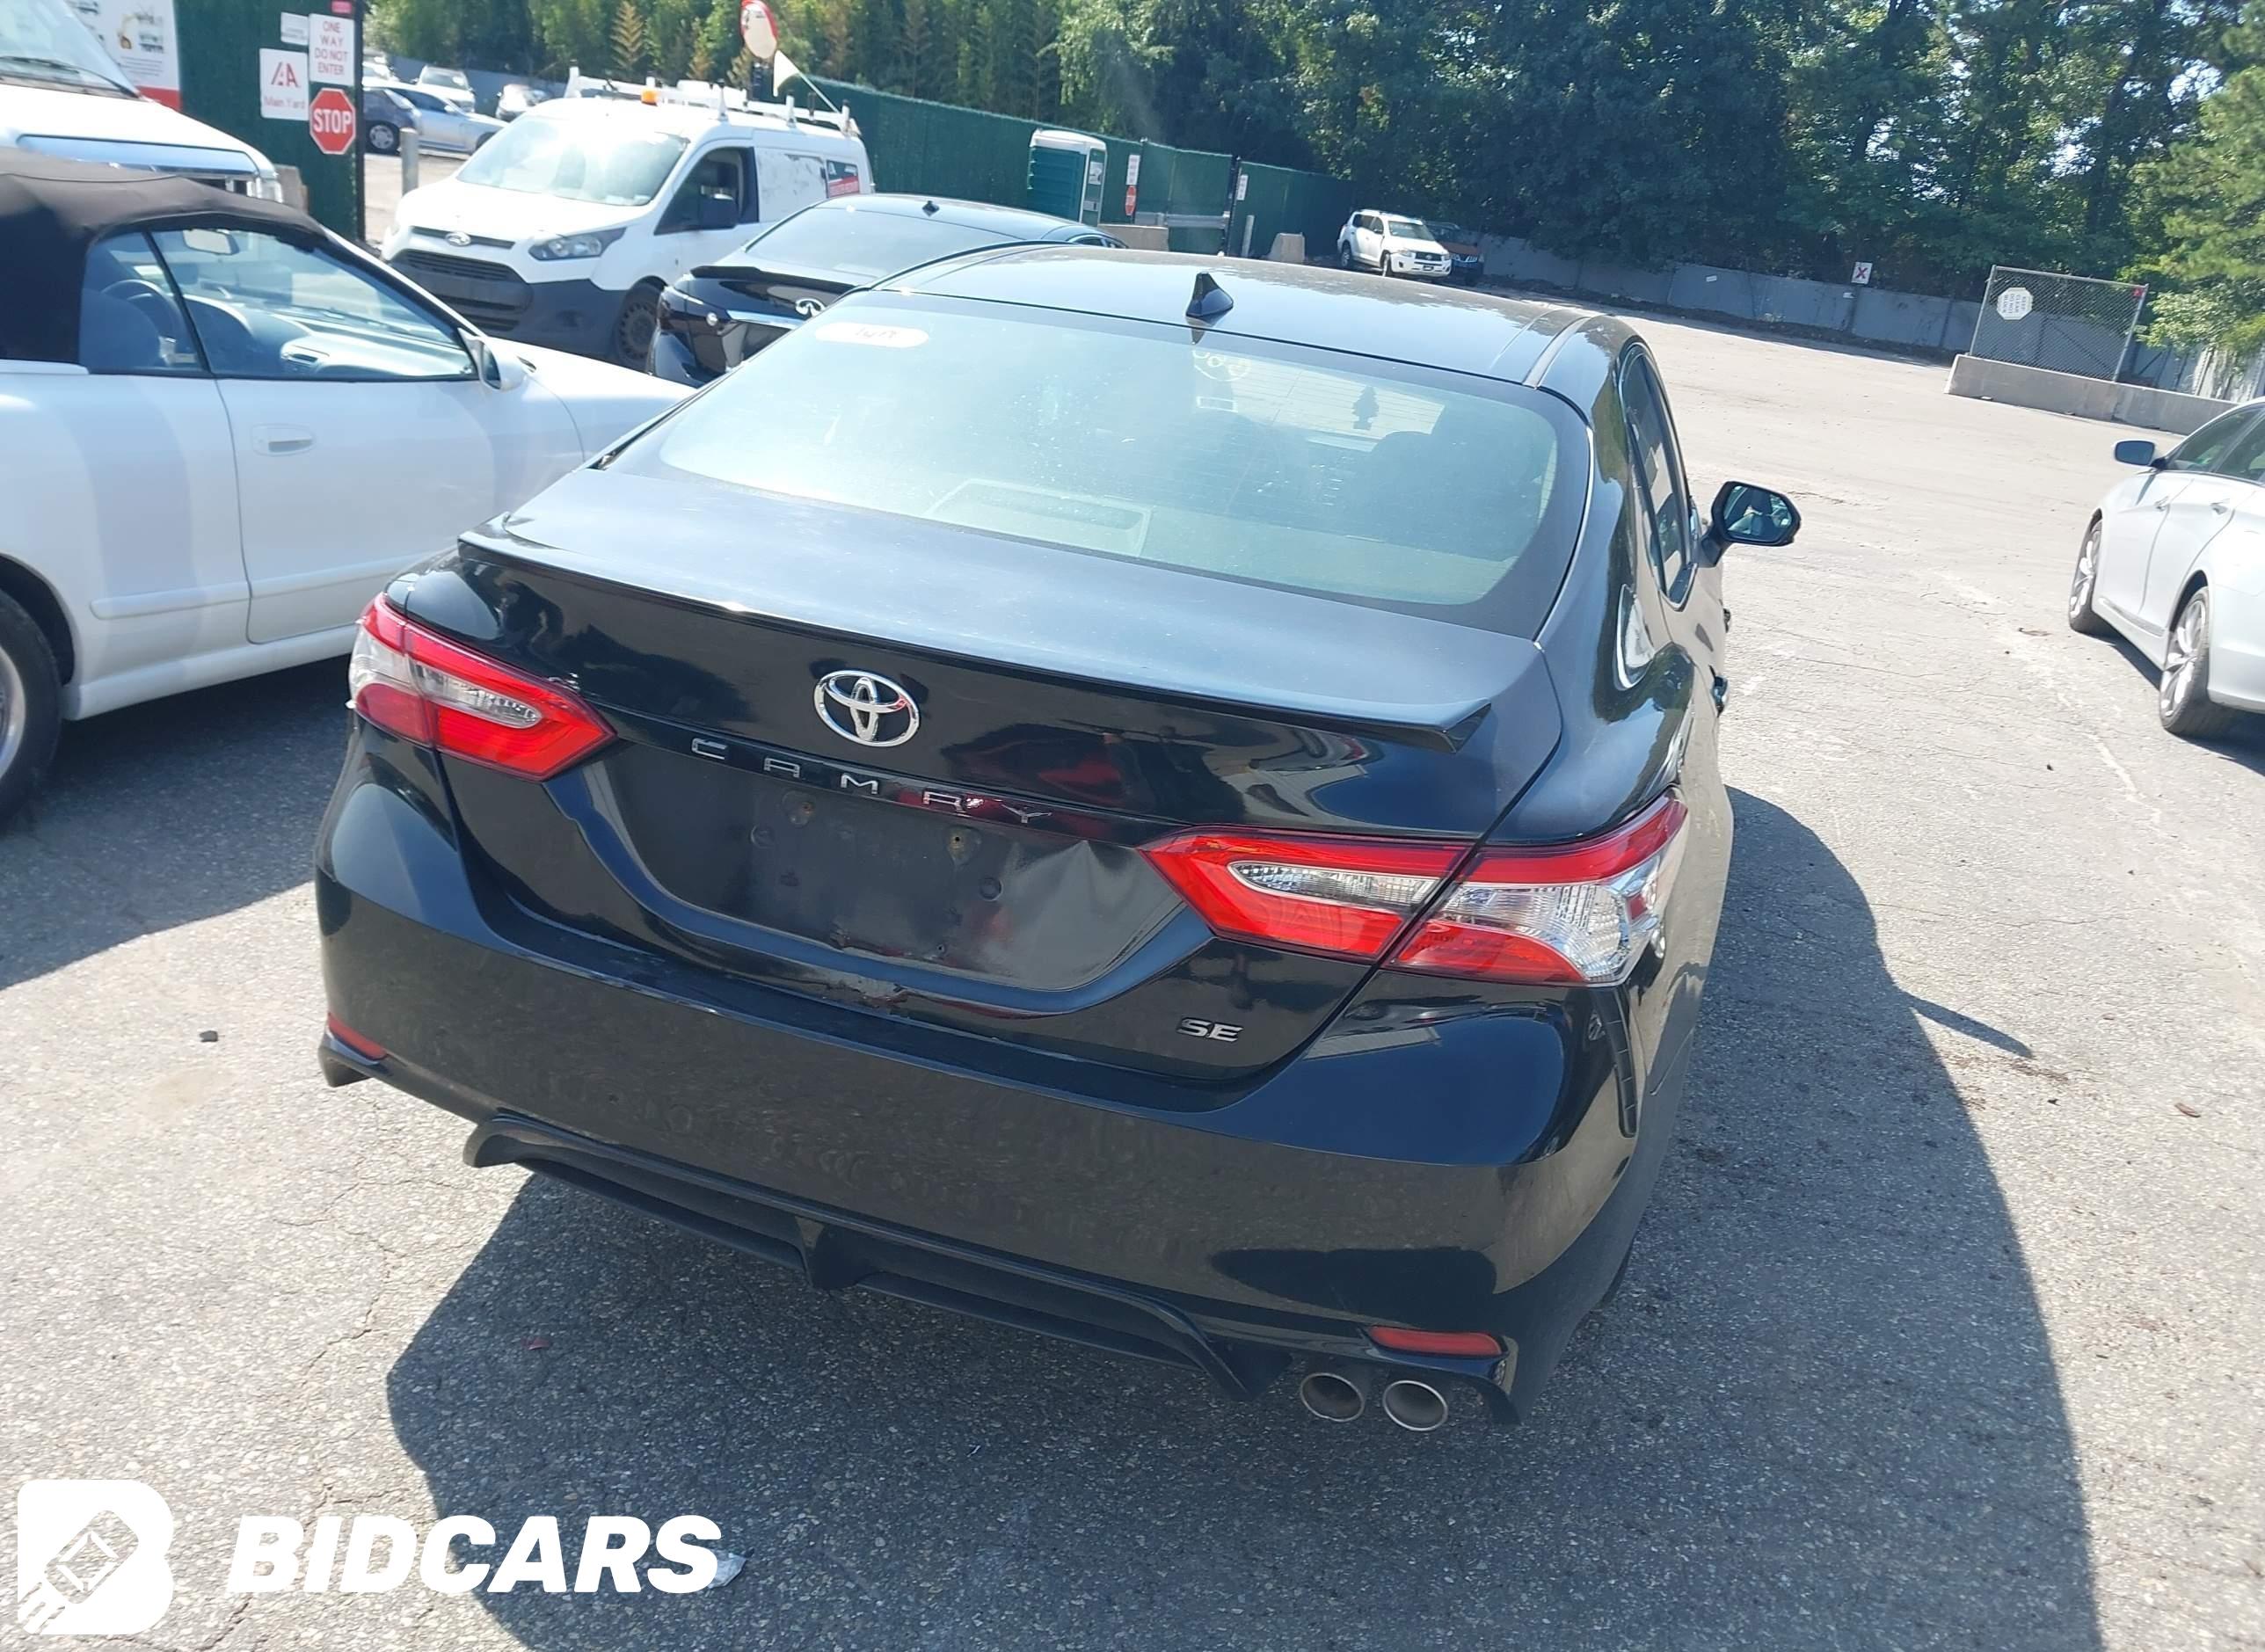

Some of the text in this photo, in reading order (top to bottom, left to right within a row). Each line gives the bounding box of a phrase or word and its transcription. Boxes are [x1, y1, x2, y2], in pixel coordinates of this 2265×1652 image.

[323, 21, 340, 33] ONE
[319, 36, 344, 47] WAY
[314, 48, 348, 62] DO NOT
[317, 62, 344, 76] ENTER
[313, 108, 352, 134] STOP
[691, 738, 1053, 824] CAMRY
[1176, 1017, 1244, 1043] SE
